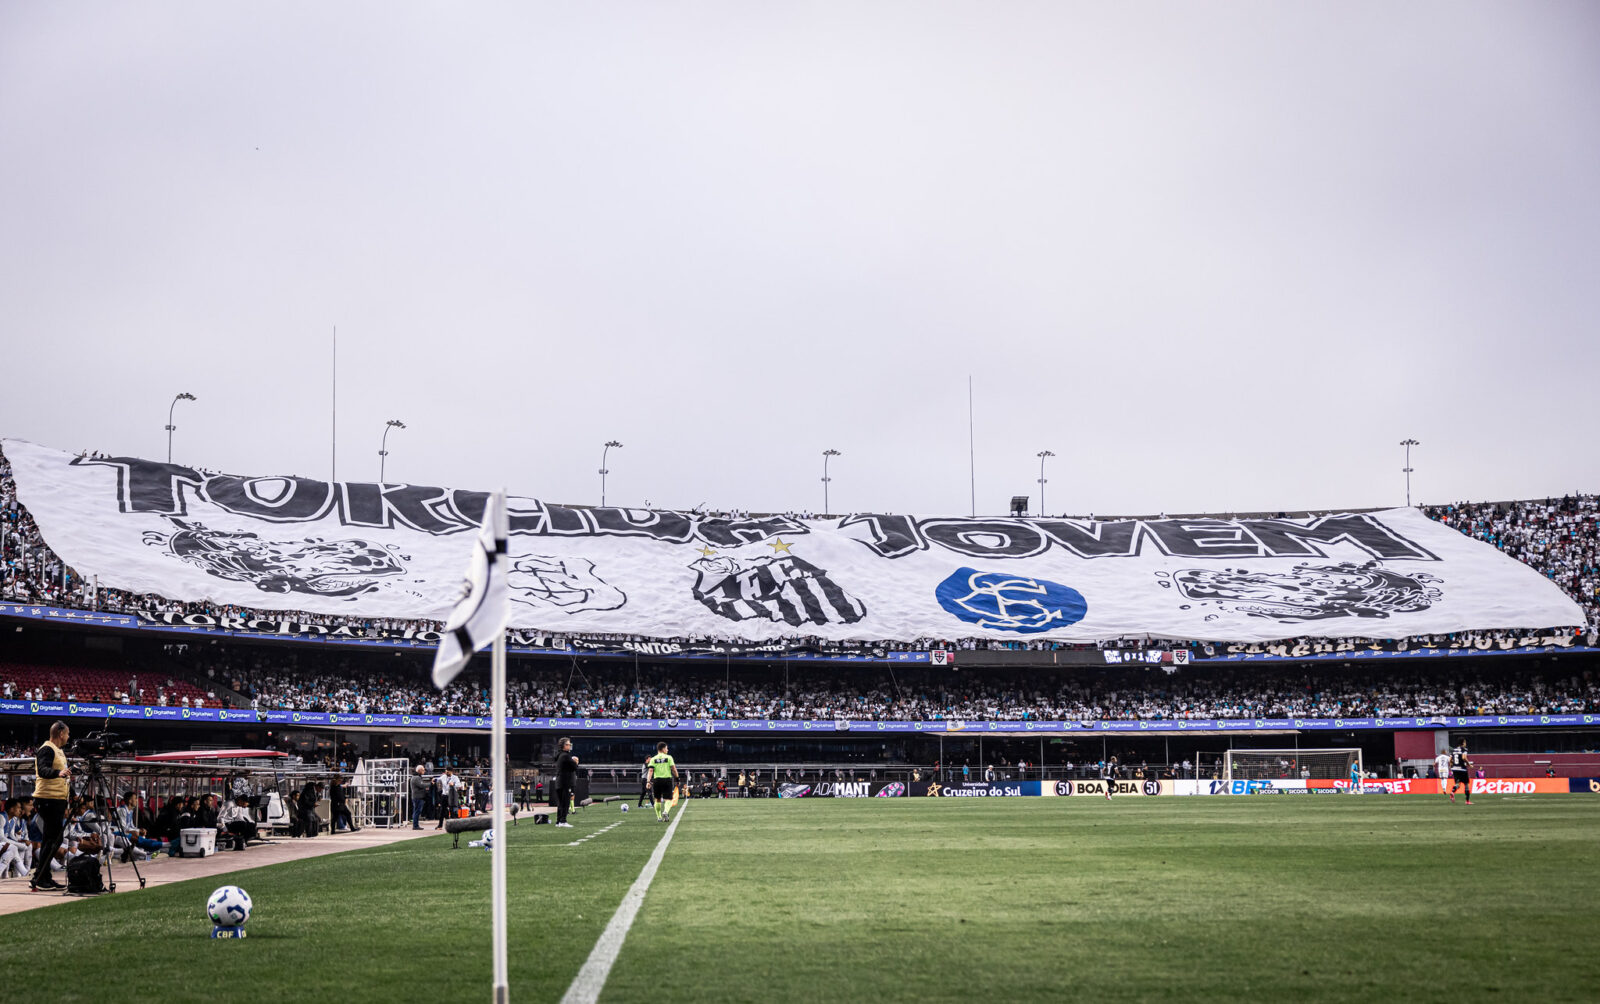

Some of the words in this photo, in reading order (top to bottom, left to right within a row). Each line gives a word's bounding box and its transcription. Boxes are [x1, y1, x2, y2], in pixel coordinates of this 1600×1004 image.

[837, 513, 1443, 560] JOVEM
[623, 642, 681, 655] SANTOS
[1138, 652, 1145, 662] 1
[1454, 754, 1460, 764] 6
[381, 771, 398, 782] cbf
[813, 782, 871, 796] ADAMANT
[943, 787, 987, 797] Cruzeiro
[989, 786, 1002, 797] do
[1004, 786, 1021, 797] Sul
[1058, 782, 1070, 795] 51
[1077, 783, 1103, 793] BOA
[1113, 783, 1138, 793] DEIA
[1146, 782, 1158, 794] 51
[1471, 779, 1536, 794] Betano
[217, 930, 234, 938] CBF
